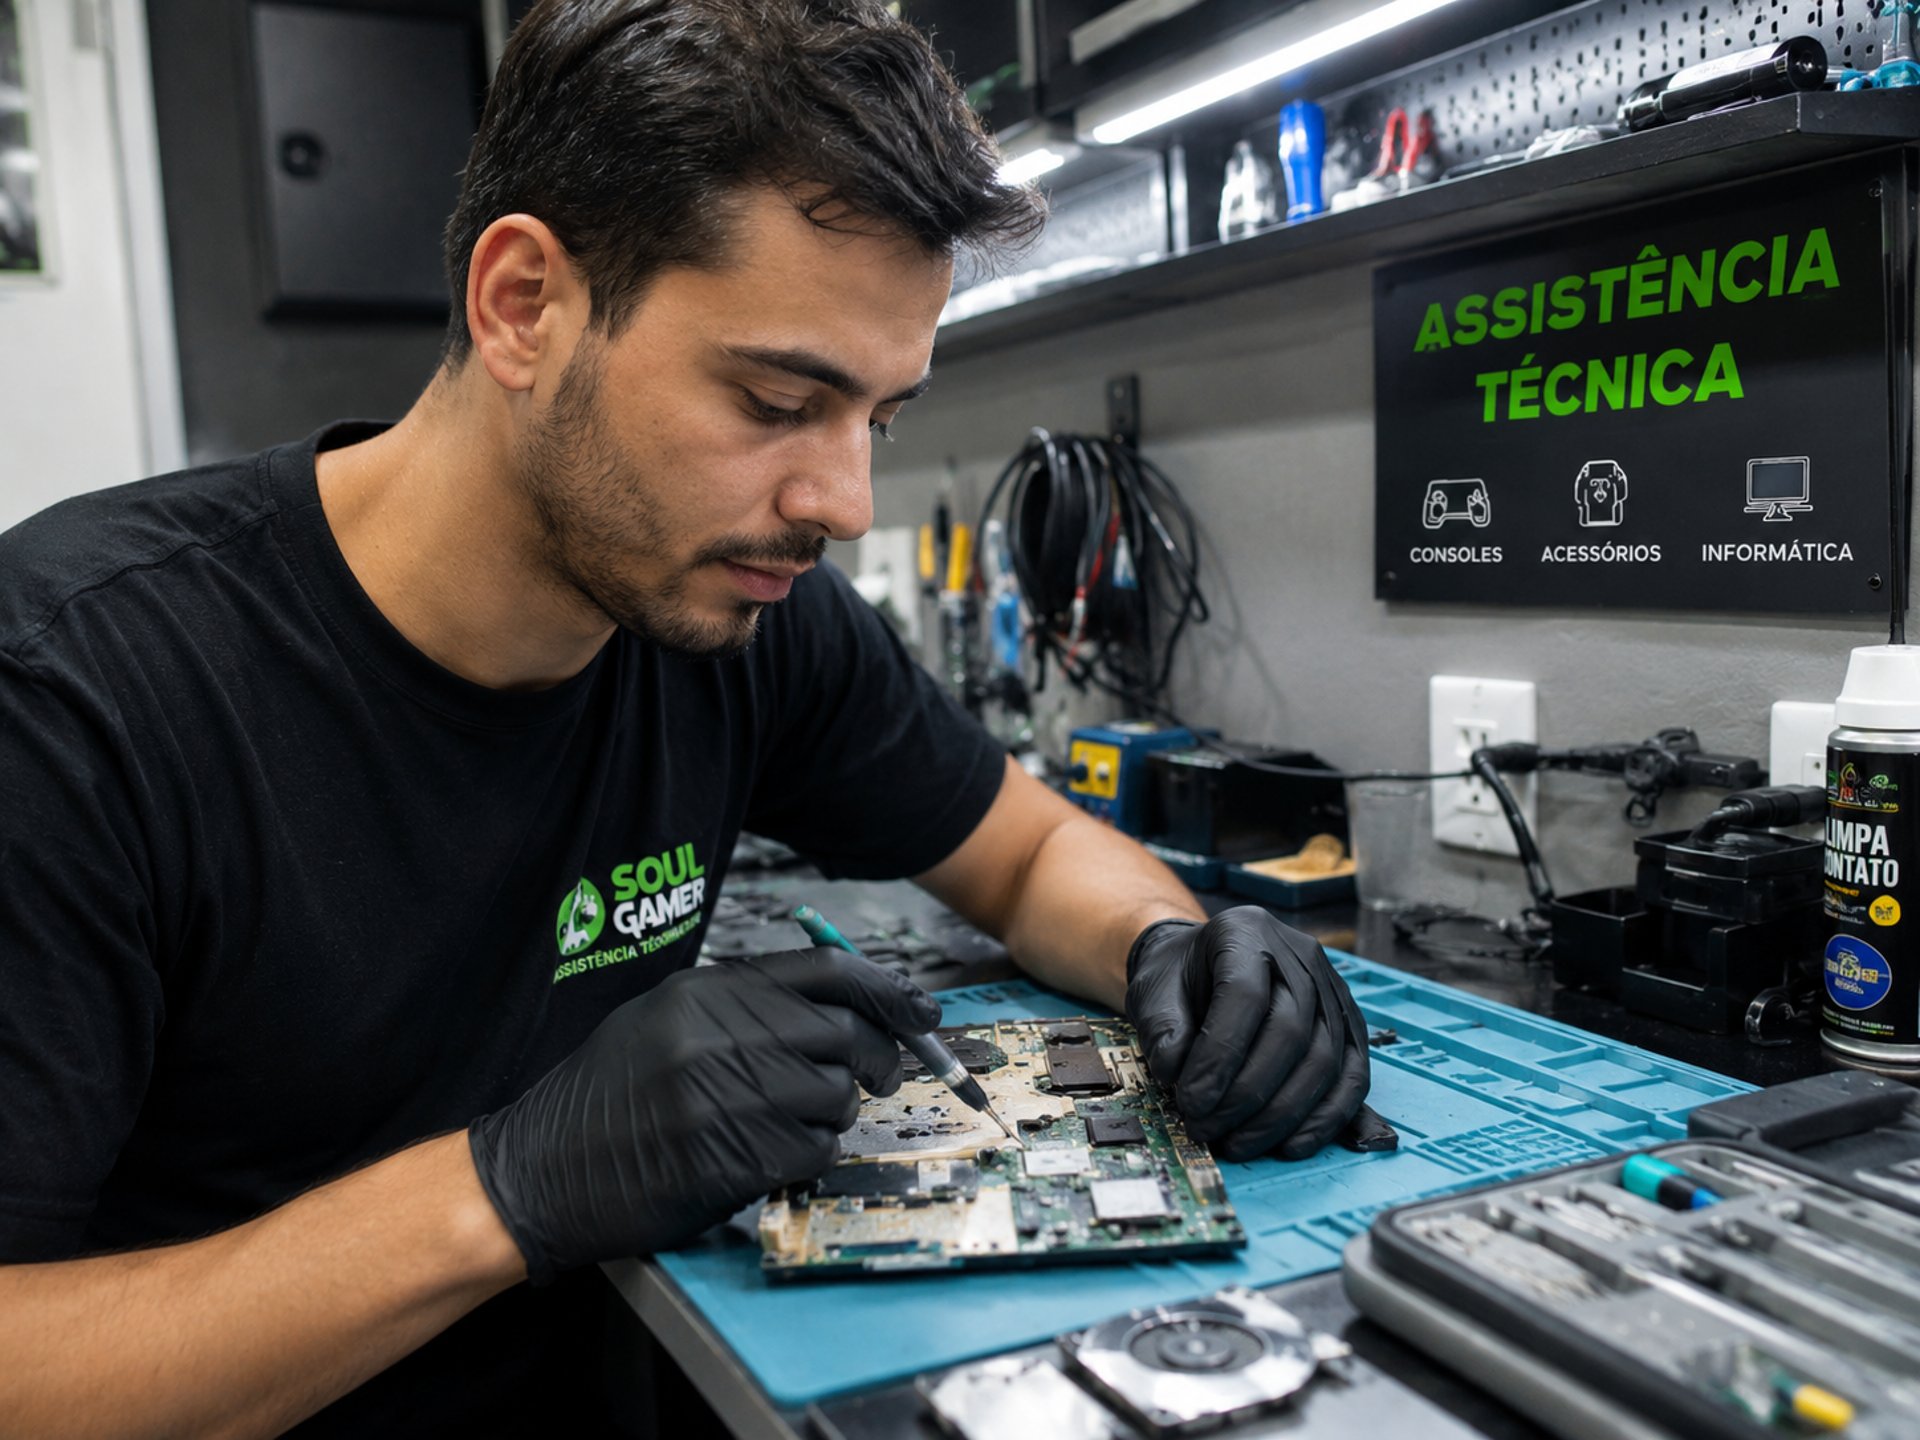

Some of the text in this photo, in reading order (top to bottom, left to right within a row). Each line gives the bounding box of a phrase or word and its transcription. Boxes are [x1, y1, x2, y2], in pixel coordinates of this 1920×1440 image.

[1413, 227, 1841, 353] ASSISTÊNCIA
[1475, 342, 1745, 423] TÉCNICA
[1409, 546, 1503, 564] CONSOLES
[1540, 540, 1662, 563] ACESSÓRIOS
[1701, 539, 1854, 563] INFORMÁTICA
[1825, 816, 1890, 856] LIMPA
[611, 842, 705, 901] SOUL
[612, 876, 705, 939] GAMER
